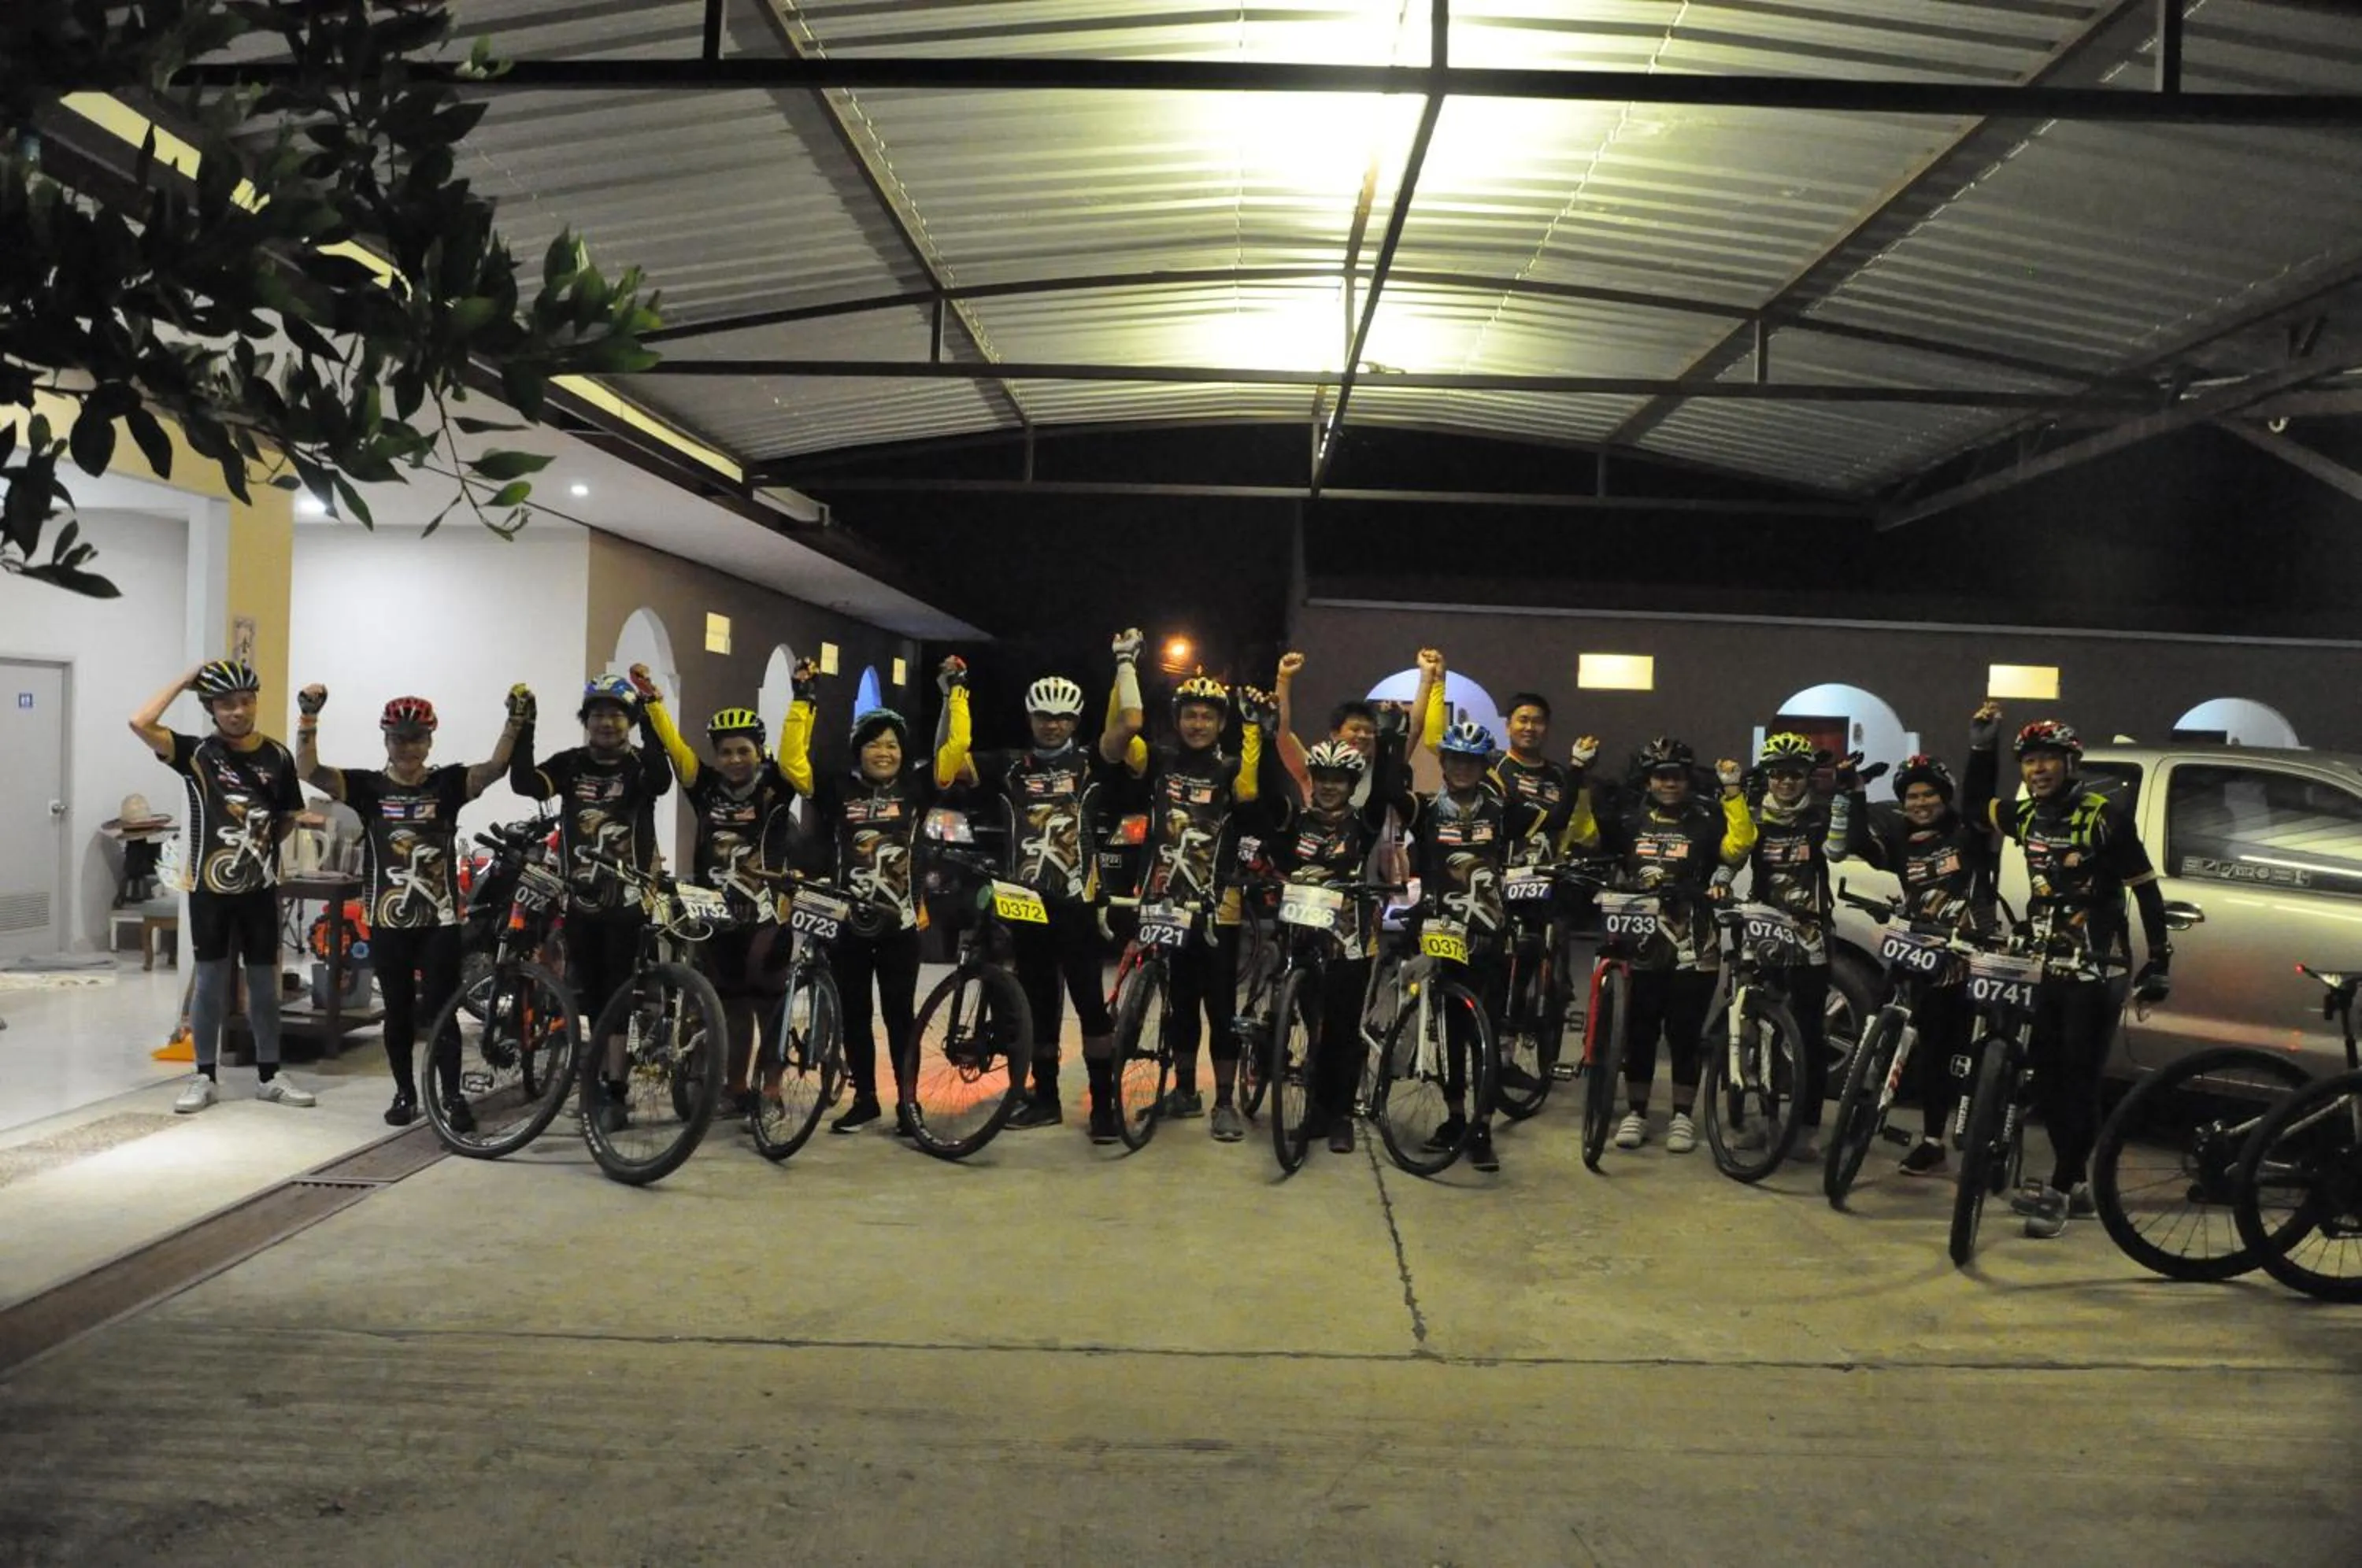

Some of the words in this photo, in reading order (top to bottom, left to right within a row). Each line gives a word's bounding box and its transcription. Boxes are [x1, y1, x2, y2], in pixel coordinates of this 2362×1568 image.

[1508, 882, 1549, 899] 0737
[687, 901, 731, 919] 0732
[1000, 900, 1043, 920] 0372
[791, 910, 839, 938] 0723
[1607, 915, 1656, 934] 0733
[1749, 920, 1794, 944] 0743
[1139, 925, 1183, 946] 0721
[1883, 939, 1937, 970] 0740
[1973, 978, 2033, 1007] 0741
